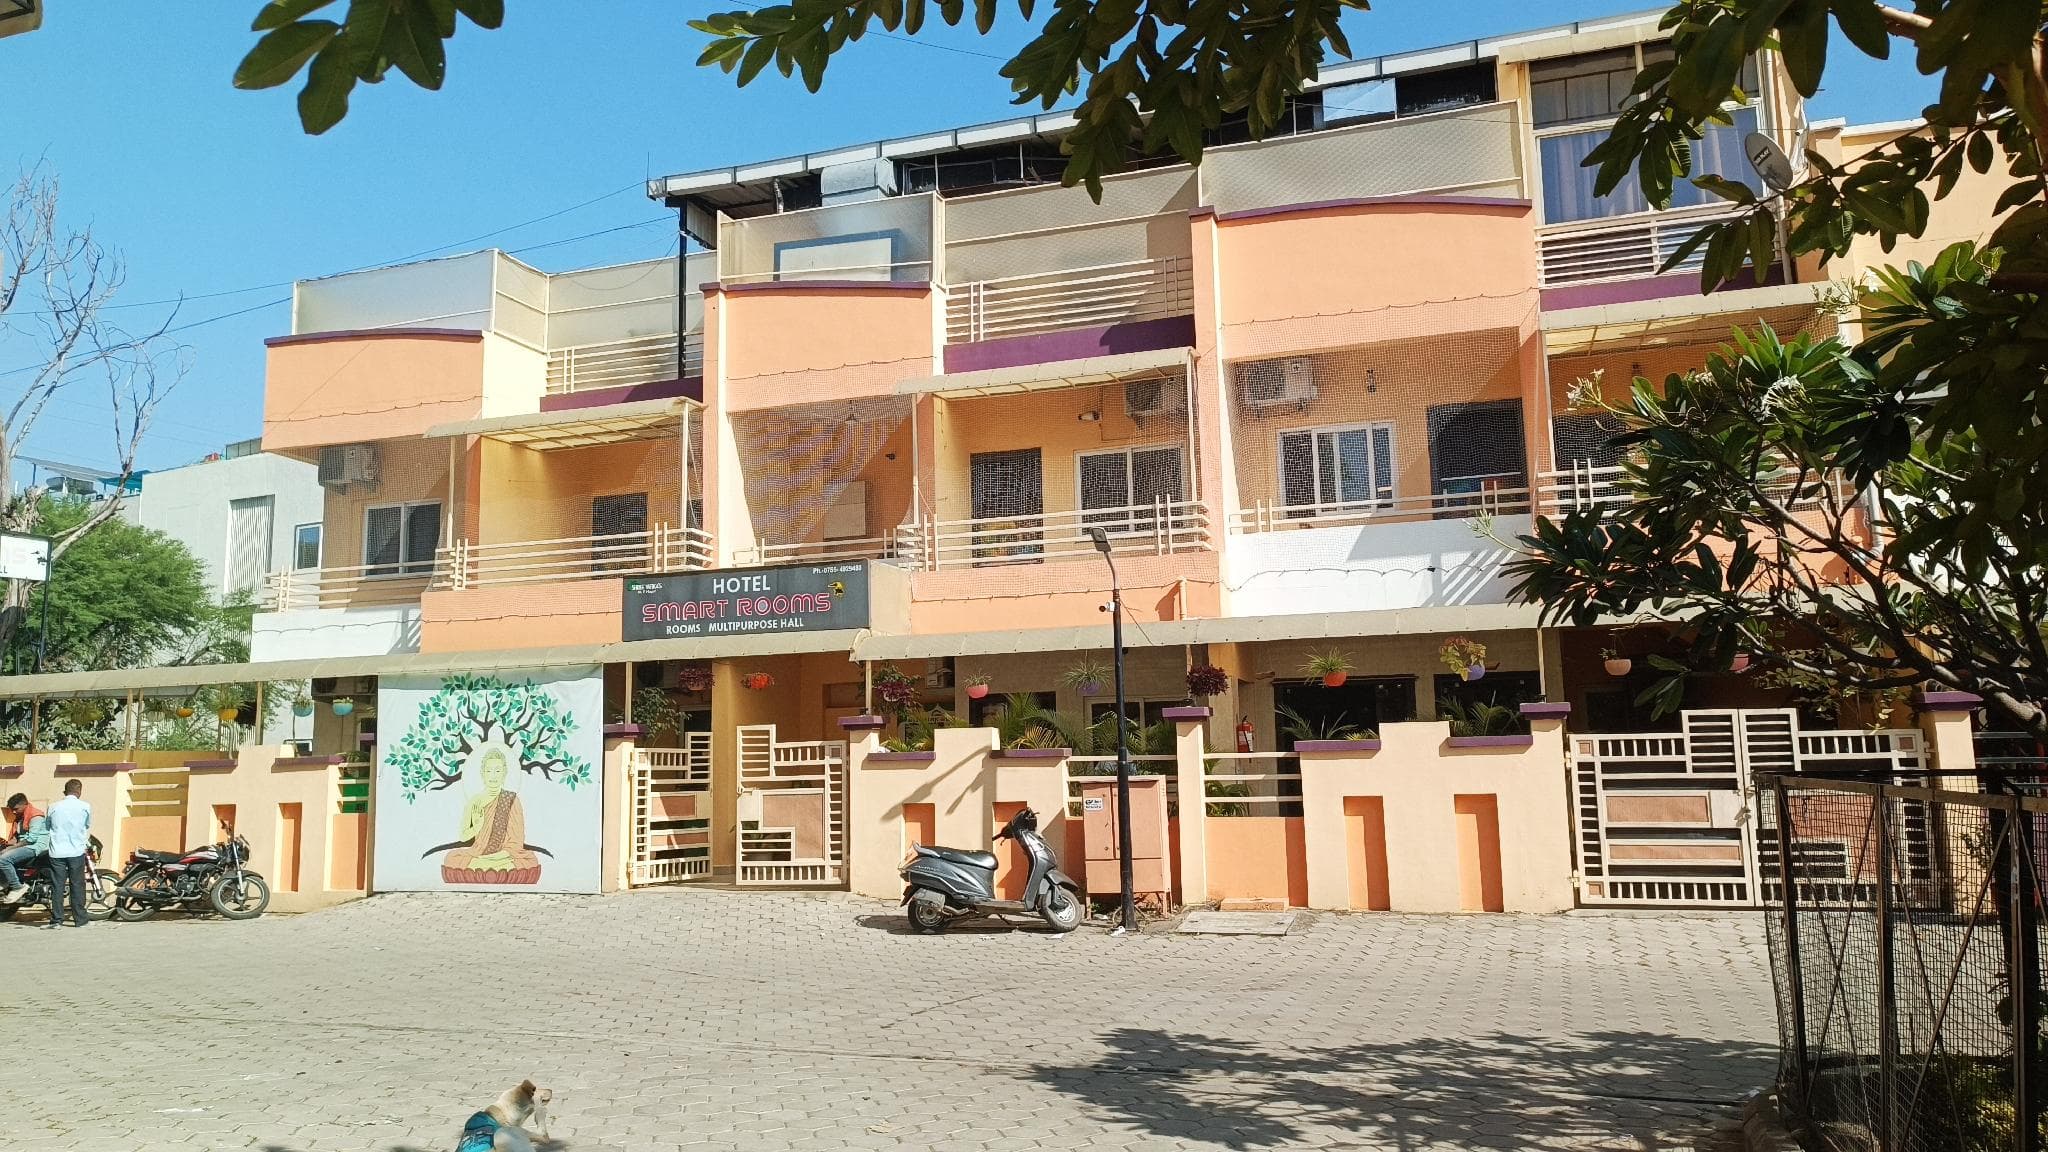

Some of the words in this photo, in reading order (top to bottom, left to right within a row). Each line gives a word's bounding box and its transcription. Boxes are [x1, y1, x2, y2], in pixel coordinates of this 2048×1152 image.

[713, 574, 771, 594] HOTEL
[642, 599, 729, 623] SMART
[736, 592, 831, 617] ROOMS
[666, 623, 701, 635] ROOMS
[708, 619, 778, 632] MULTIPURPOSE
[780, 617, 804, 629] HALL
